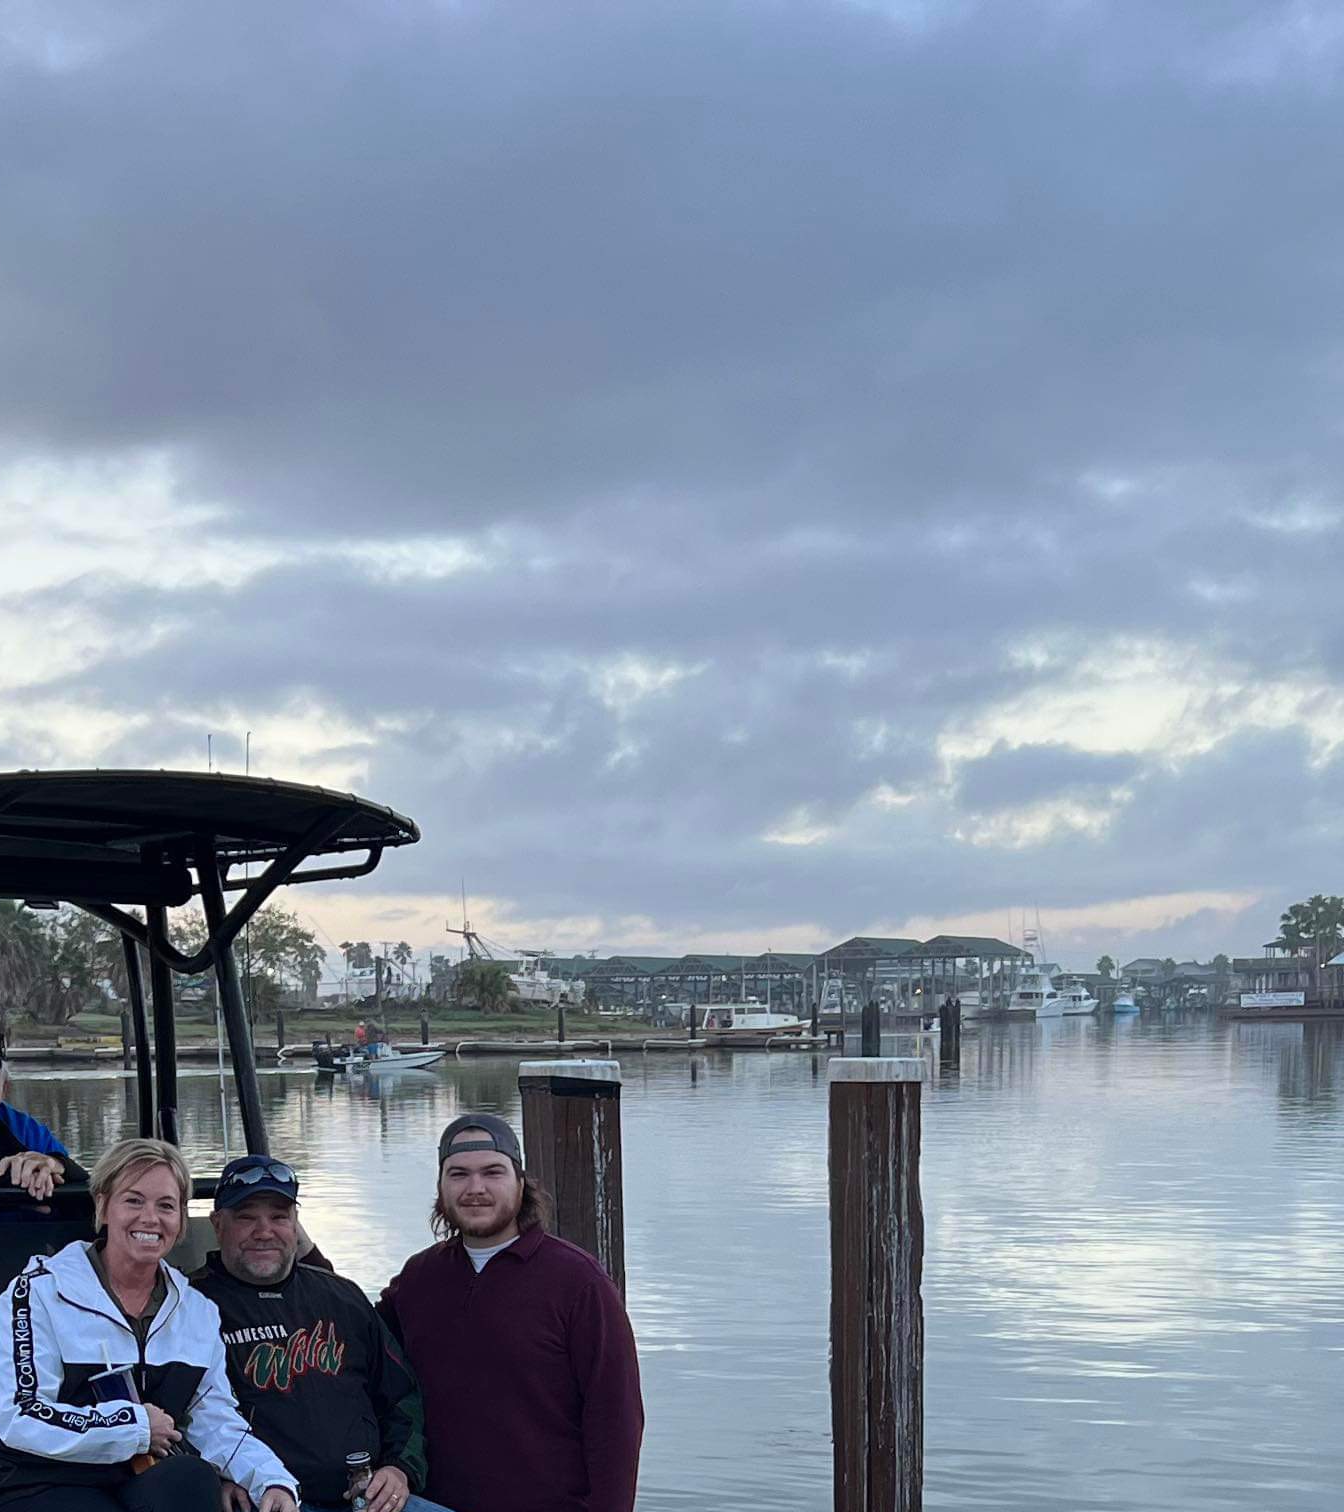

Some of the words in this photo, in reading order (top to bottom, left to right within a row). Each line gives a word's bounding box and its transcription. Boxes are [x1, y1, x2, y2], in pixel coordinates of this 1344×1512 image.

[15, 1307, 28, 1342] Klein
[17, 1343, 35, 1388] Calvin
[243, 1318, 346, 1392] Wild
